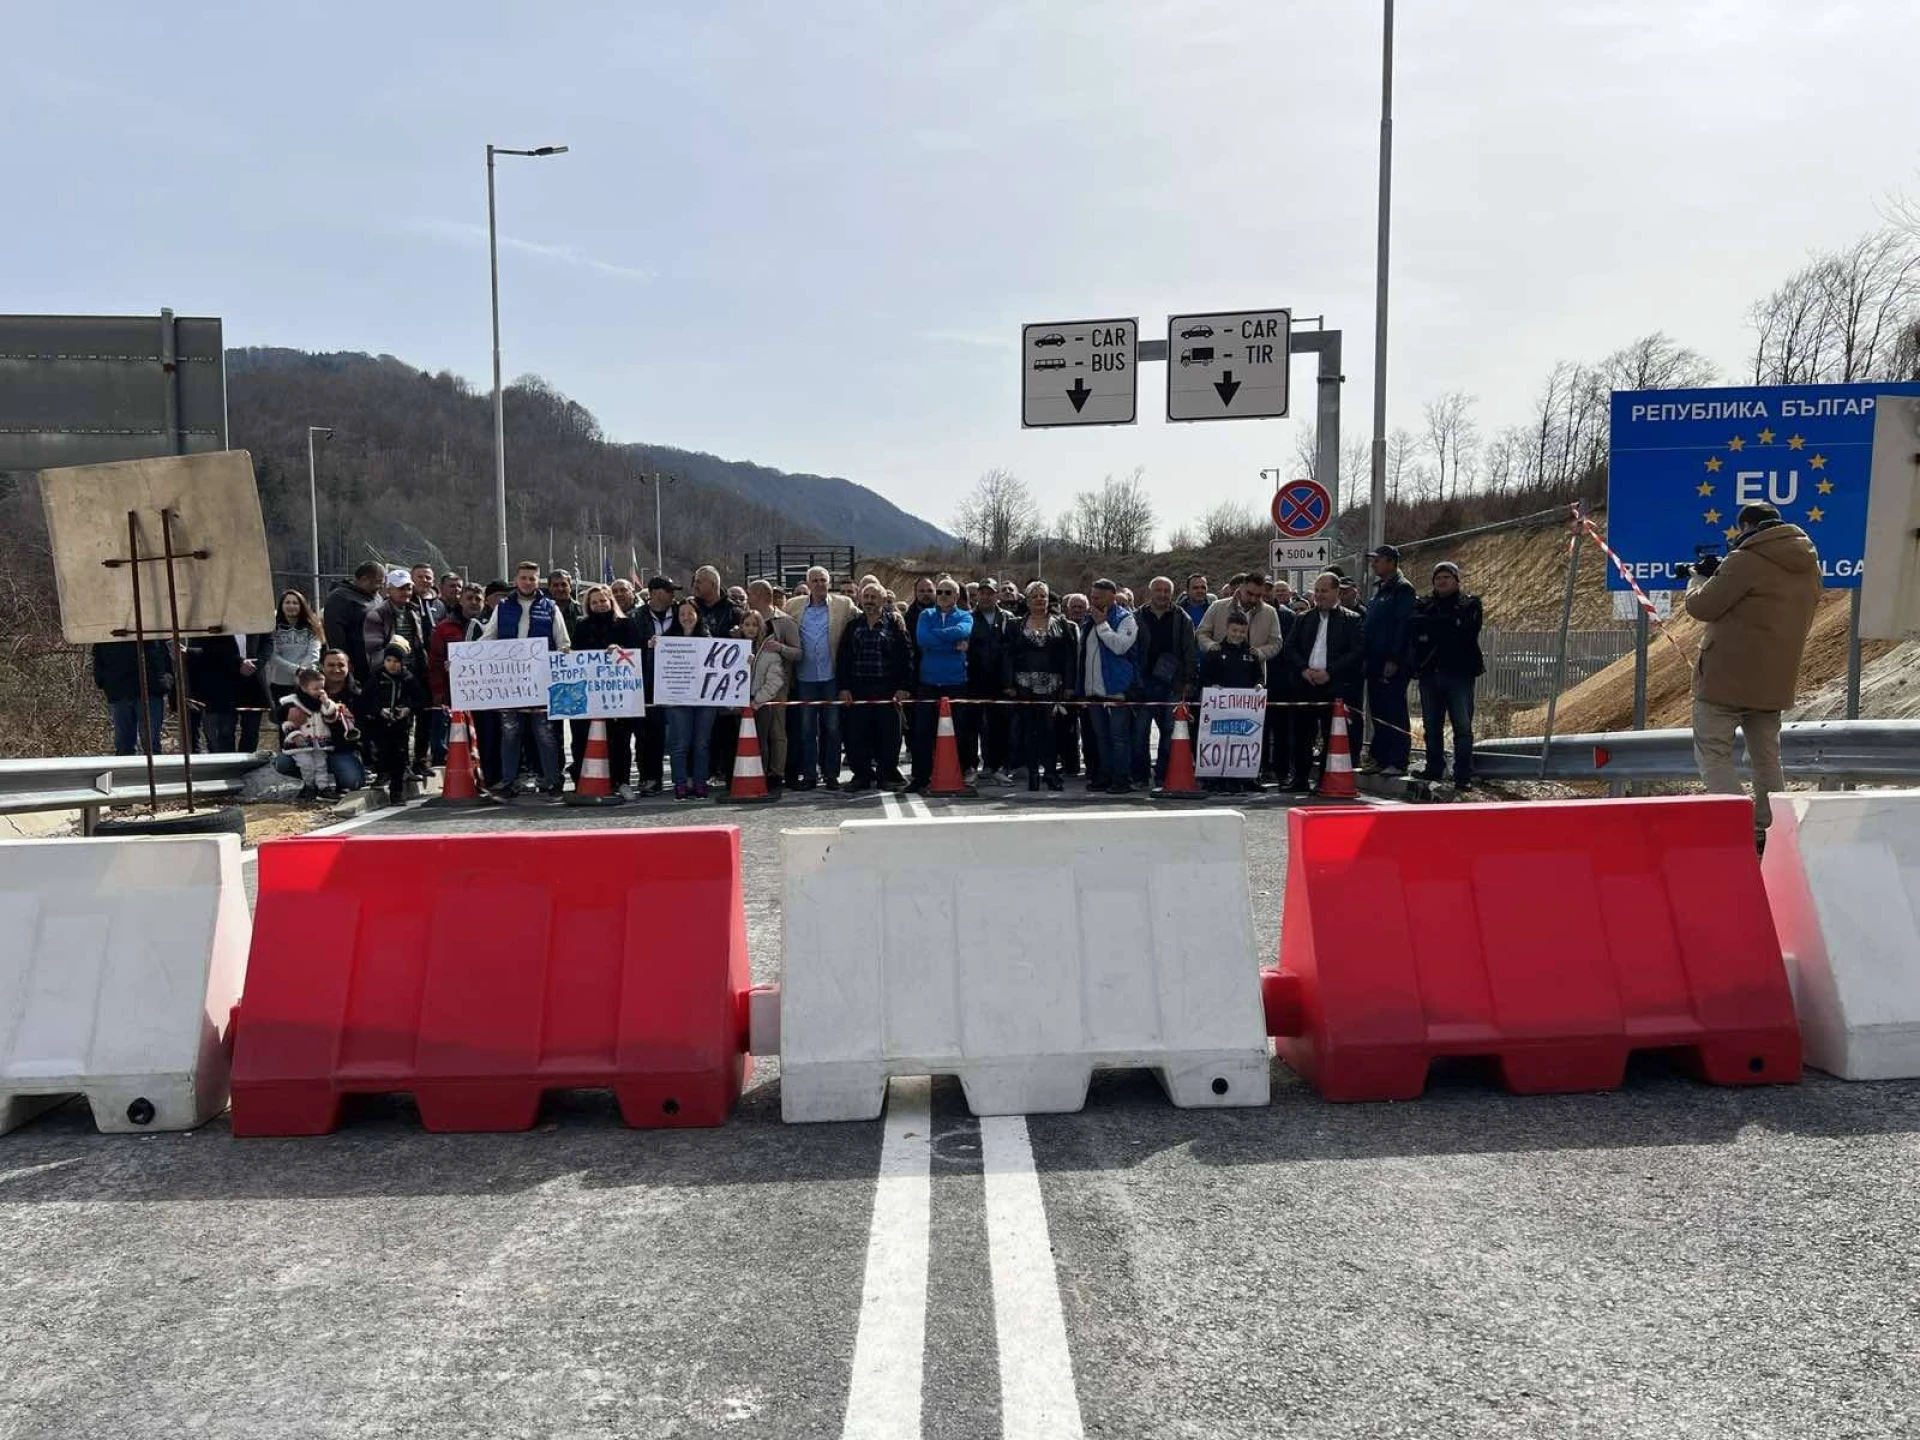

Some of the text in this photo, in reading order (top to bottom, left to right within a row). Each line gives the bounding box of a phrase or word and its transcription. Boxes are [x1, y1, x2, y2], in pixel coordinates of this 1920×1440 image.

[1091, 328, 1126, 347] CAR
[1241, 319, 1278, 340] CAR
[1091, 353, 1126, 372] BUS
[1245, 344, 1274, 365] TIR
[1631, 398, 1875, 422] РЕПУБЛИКА БЪЛГАР
[1735, 470, 1799, 505] EU
[549, 652, 613, 669] НЕ СМЕ
[703, 641, 741, 669] КО
[458, 663, 476, 678] 25
[551, 667, 587, 681] ВТОРА
[700, 669, 749, 701] ГА?
